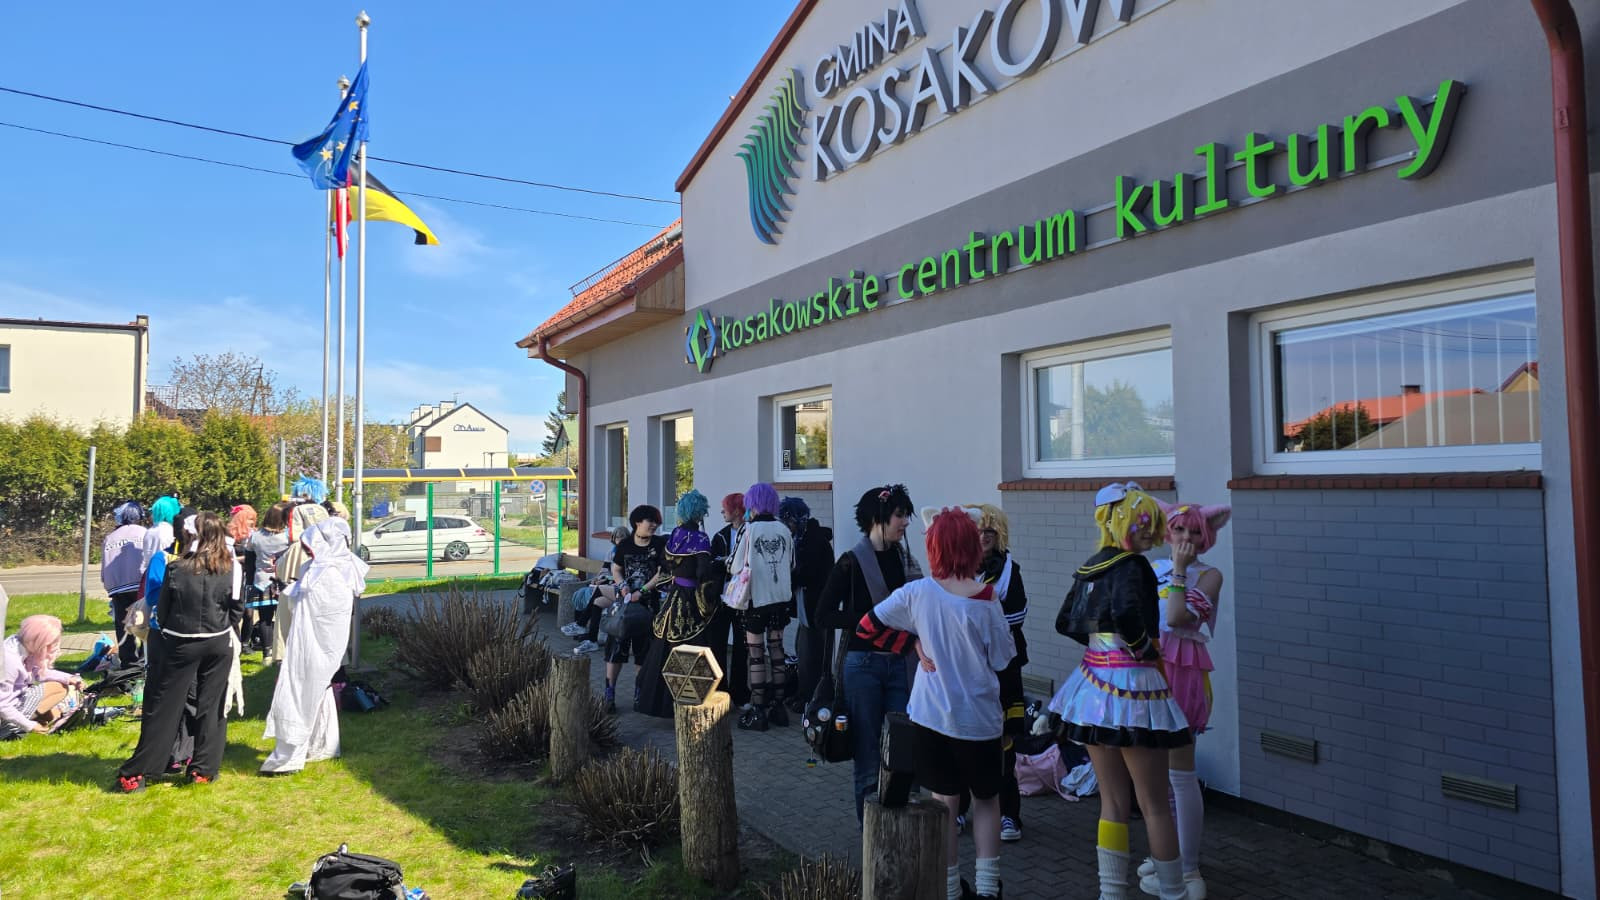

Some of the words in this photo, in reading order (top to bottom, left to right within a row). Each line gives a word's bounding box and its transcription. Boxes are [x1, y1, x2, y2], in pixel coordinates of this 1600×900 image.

[813, 1, 920, 98] GMINA
[720, 271, 879, 350] kosakowskie
[897, 208, 1076, 299] centrum
[1115, 80, 1464, 238] kultury
